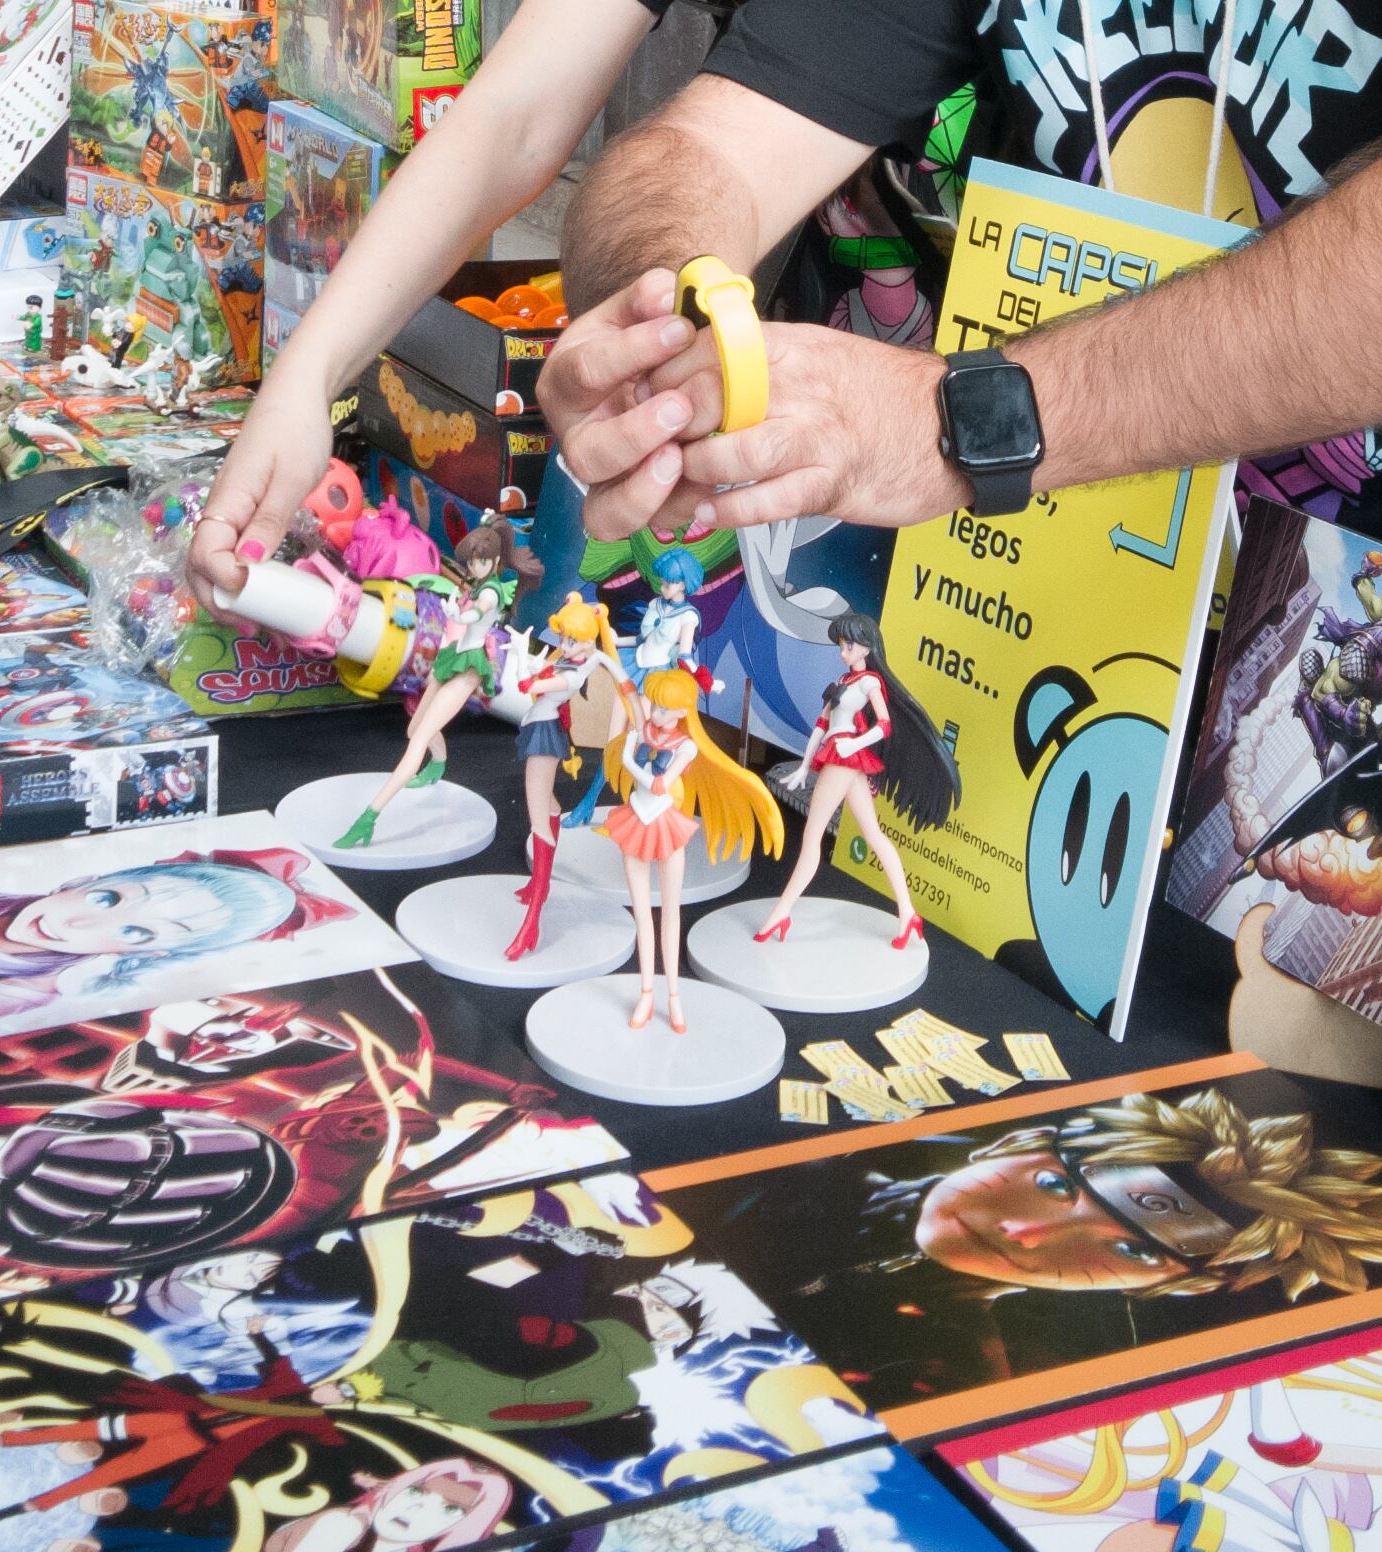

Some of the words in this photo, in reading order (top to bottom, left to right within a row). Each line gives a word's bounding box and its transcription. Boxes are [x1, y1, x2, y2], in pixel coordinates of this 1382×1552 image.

[968, 216, 1003, 252] LA
[948, 510, 1023, 565] legos
[913, 563, 932, 601] y
[936, 574, 1033, 641] mucho
[917, 635, 999, 700] mas...
